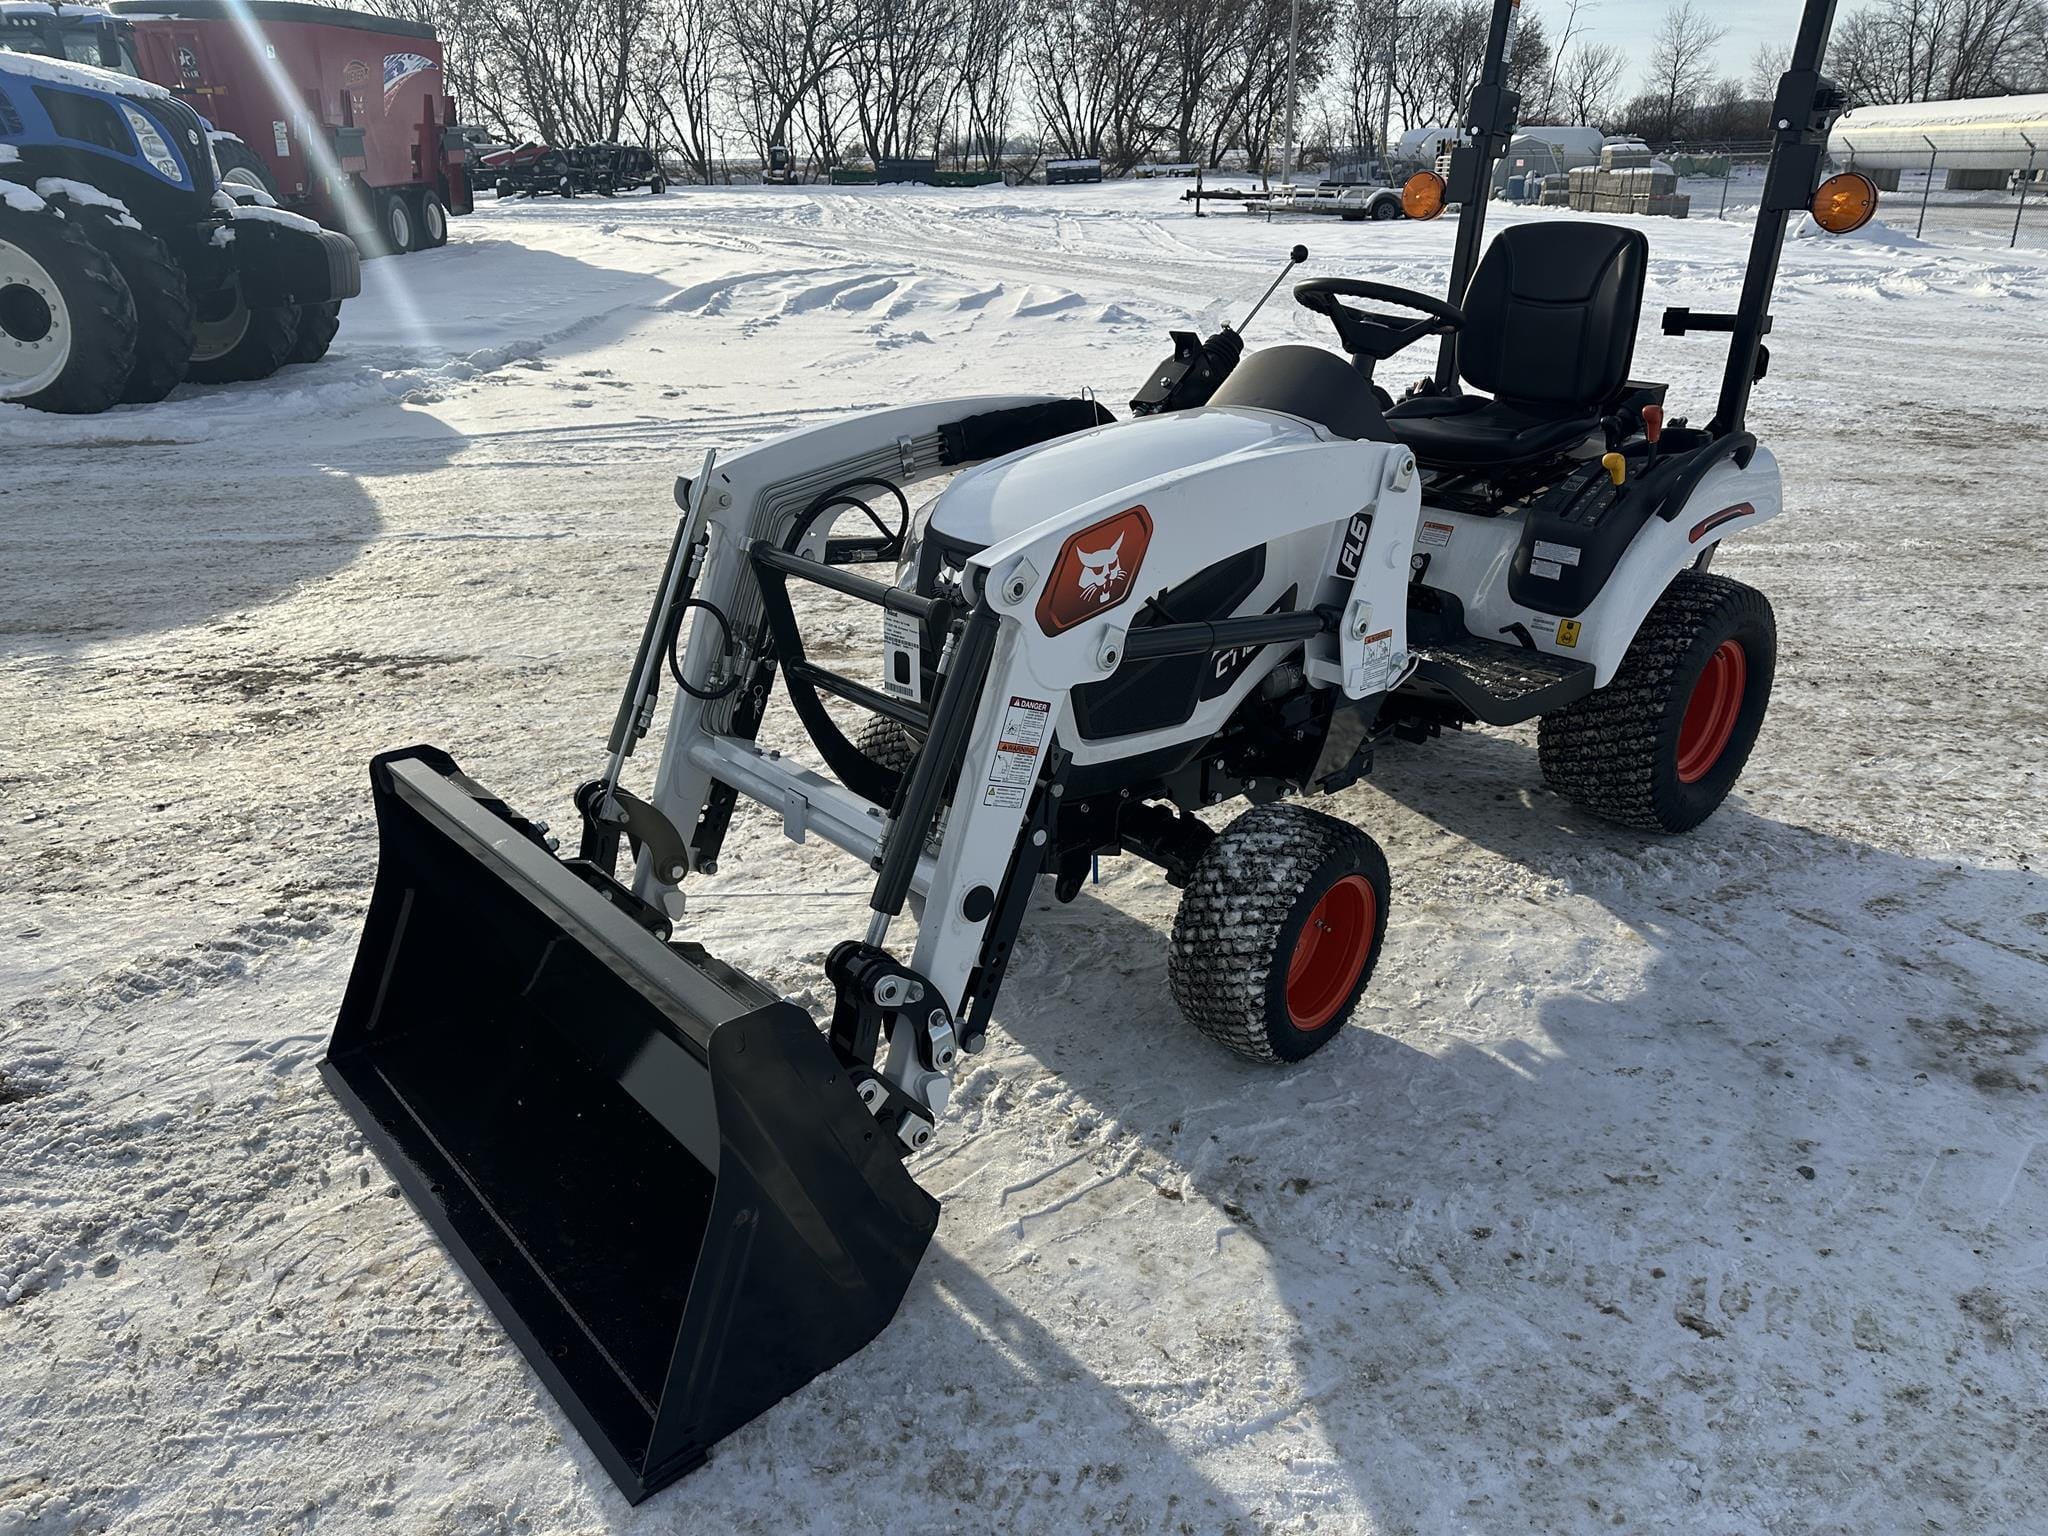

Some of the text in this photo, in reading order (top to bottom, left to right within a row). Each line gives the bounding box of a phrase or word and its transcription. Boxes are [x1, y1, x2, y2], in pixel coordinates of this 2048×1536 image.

[1341, 516, 1367, 573] FL6
[1021, 700, 1047, 711] DANGER
[1007, 744, 1035, 753] WARNING
